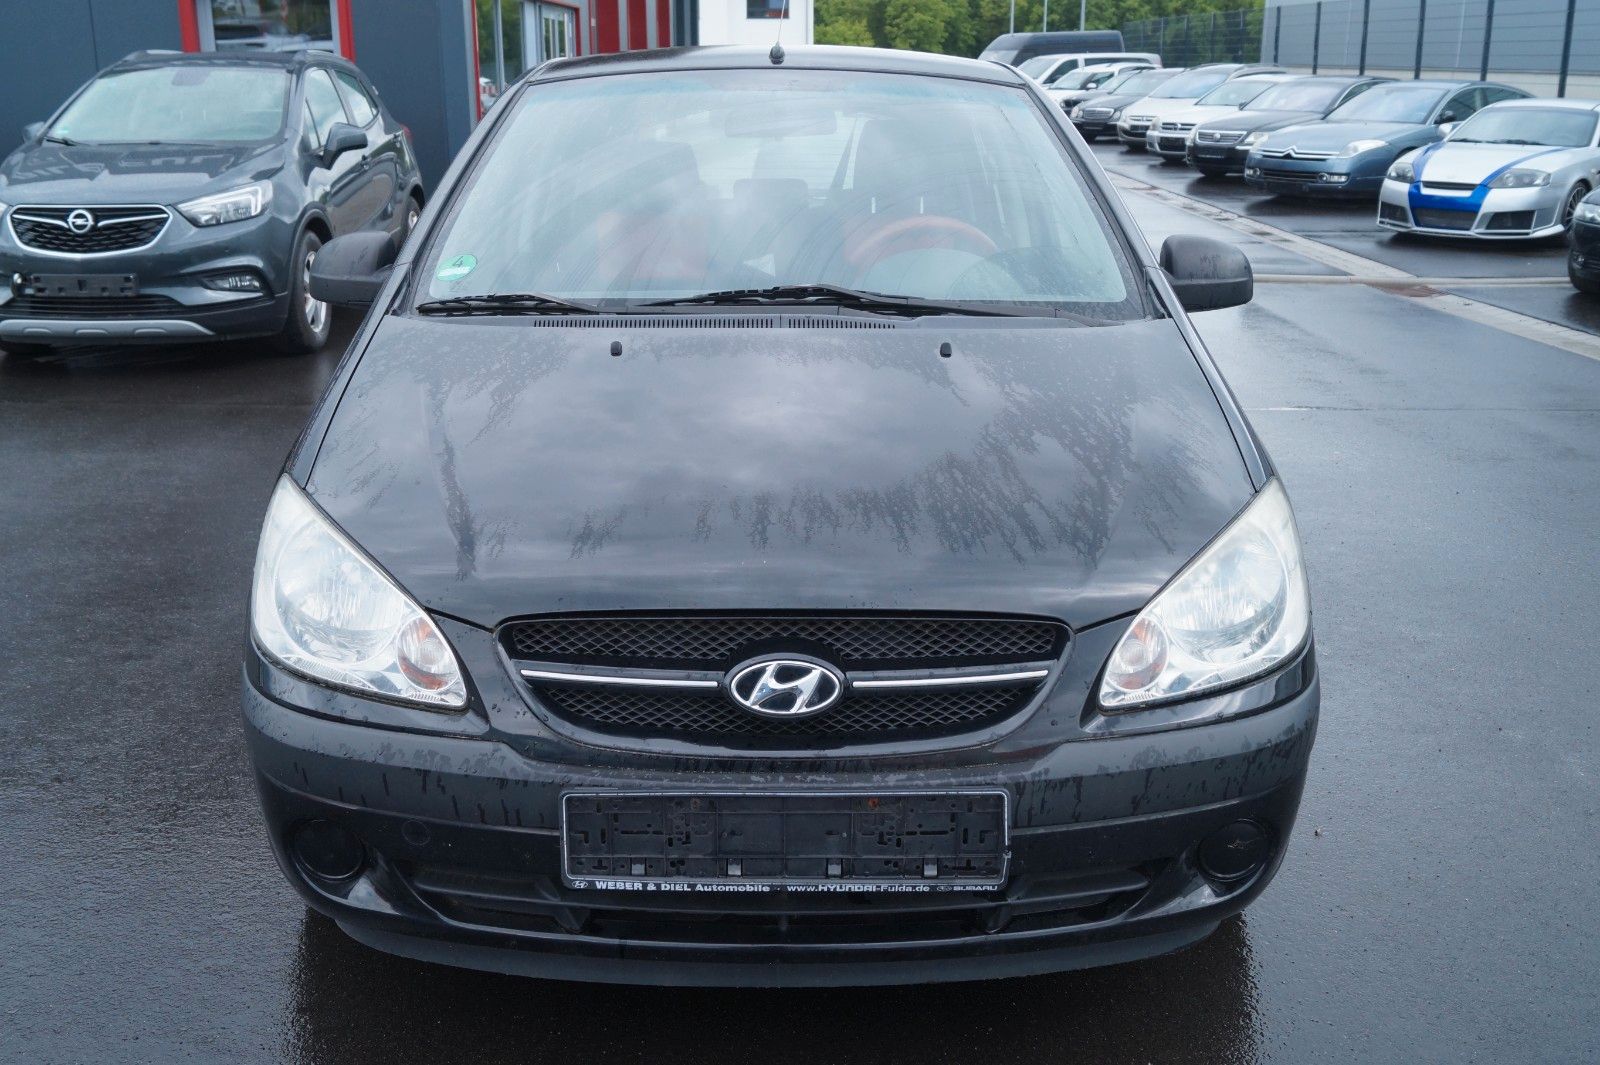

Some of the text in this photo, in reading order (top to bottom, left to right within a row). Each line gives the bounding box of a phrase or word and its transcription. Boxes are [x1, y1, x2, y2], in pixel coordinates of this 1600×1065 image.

[452, 255, 464, 267] 4
[595, 880, 643, 891] WEBER
[646, 882, 657, 891] &
[660, 883, 692, 891] DIEL
[695, 883, 771, 892] Automobile
[786, 884, 931, 892] www.HYUNDAI-Fulda.de
